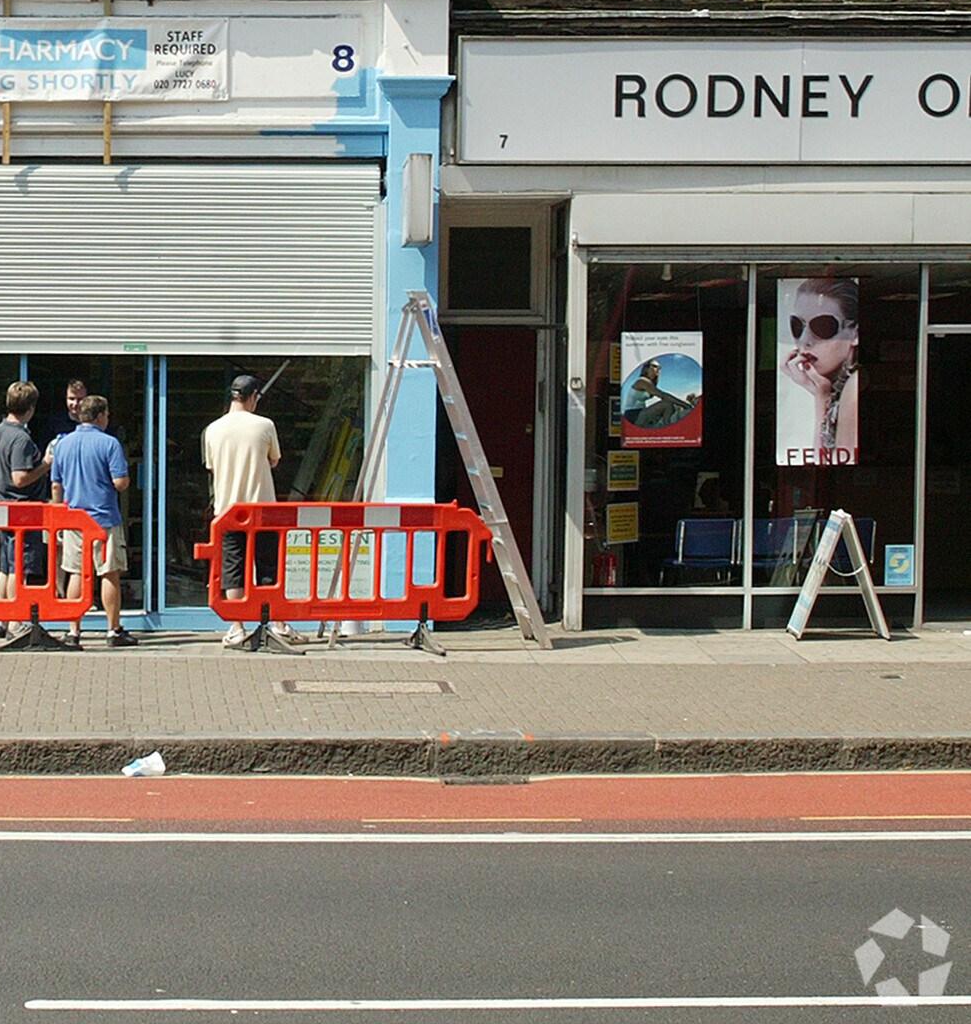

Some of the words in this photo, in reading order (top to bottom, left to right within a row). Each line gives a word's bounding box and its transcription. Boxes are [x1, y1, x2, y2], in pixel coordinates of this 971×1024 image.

[167, 30, 204, 43] STAFF
[154, 43, 217, 56] REQUIRED
[332, 44, 356, 73] 8
[175, 70, 195, 78] LUCY
[27, 73, 138, 91] SHORTLY
[154, 79, 170, 90] 020
[172, 79, 193, 90] 7727
[613, 73, 874, 118] RODNEY
[499, 134, 509, 149] 7
[787, 447, 859, 465] FENDI
